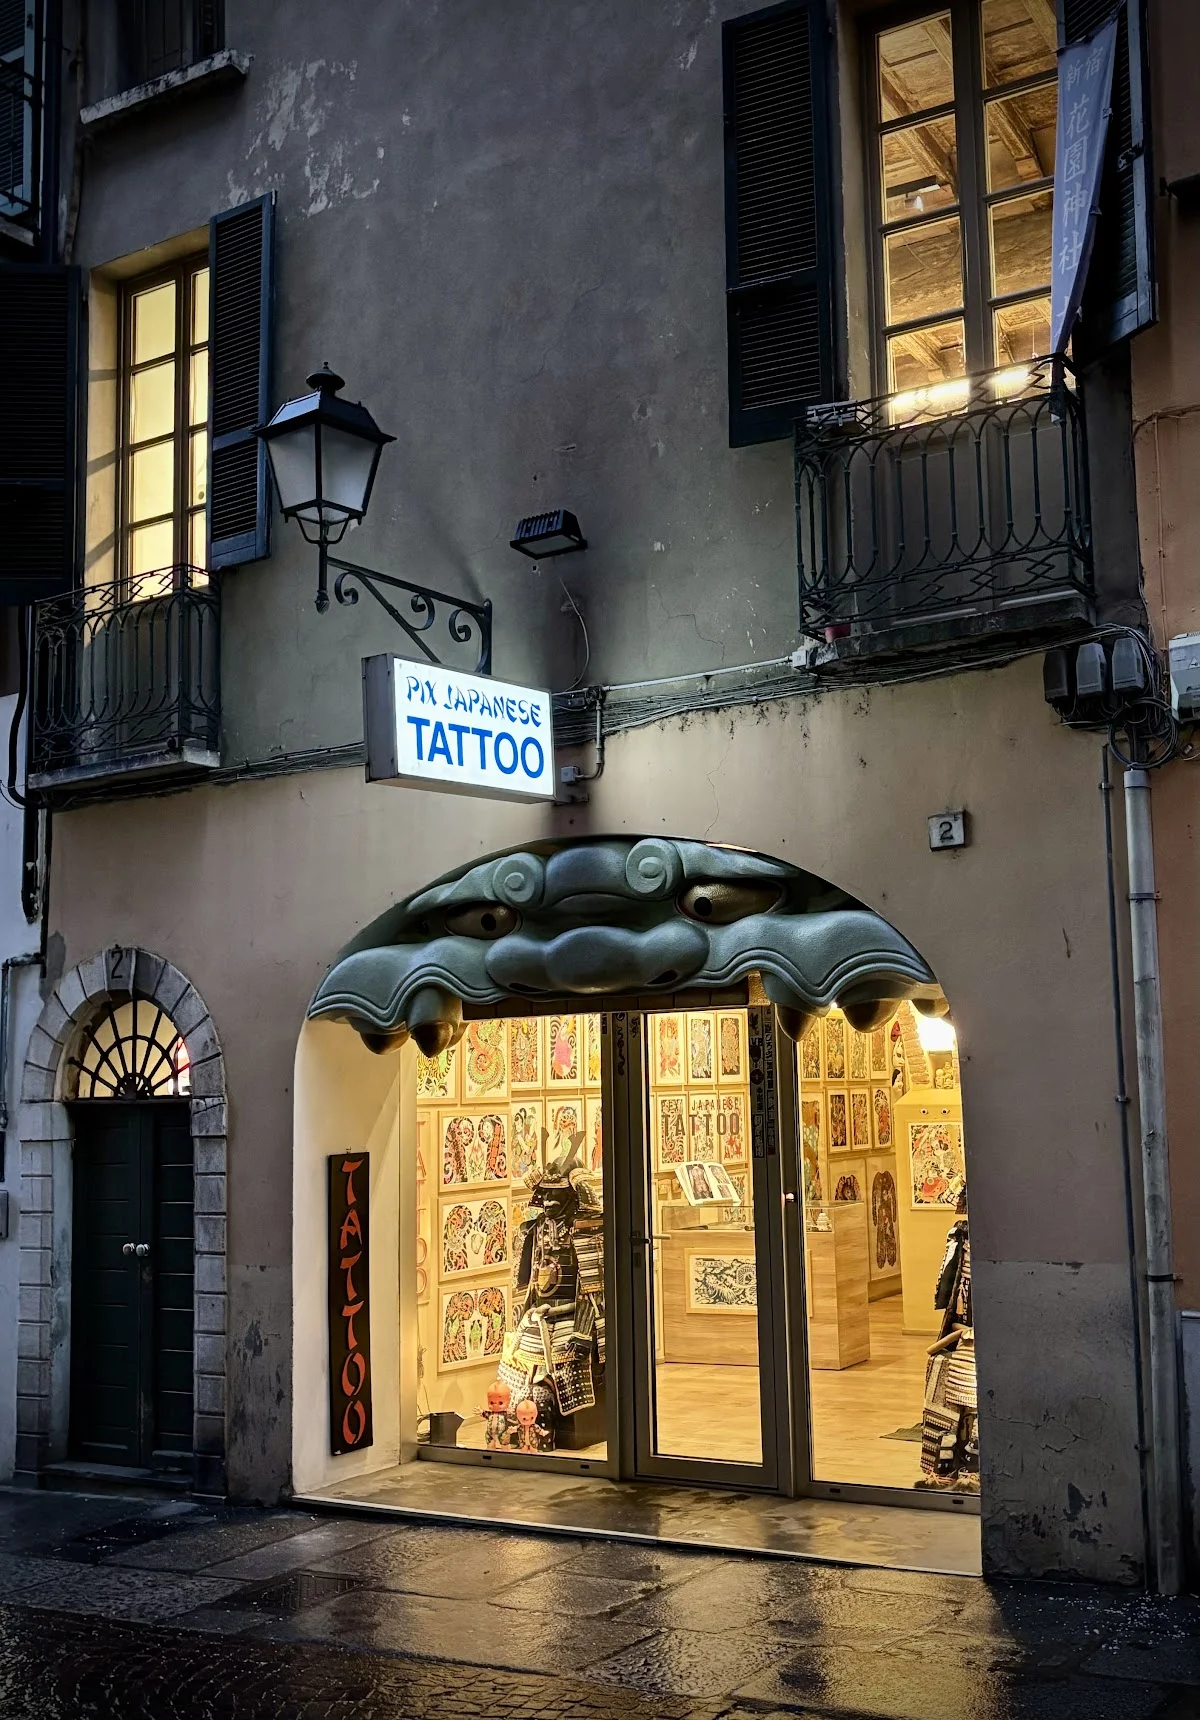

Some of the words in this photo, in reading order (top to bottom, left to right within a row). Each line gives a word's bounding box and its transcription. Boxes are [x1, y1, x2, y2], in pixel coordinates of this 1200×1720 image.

[406, 676, 437, 706] PIX
[444, 685, 541, 727] JAPANESE
[407, 716, 544, 778] TATTOO
[111, 950, 123, 979] 2
[661, 1113, 740, 1136] TATTOO
[692, 1099, 739, 1110] JAPANESE
[340, 1159, 366, 1445] TATTOO
